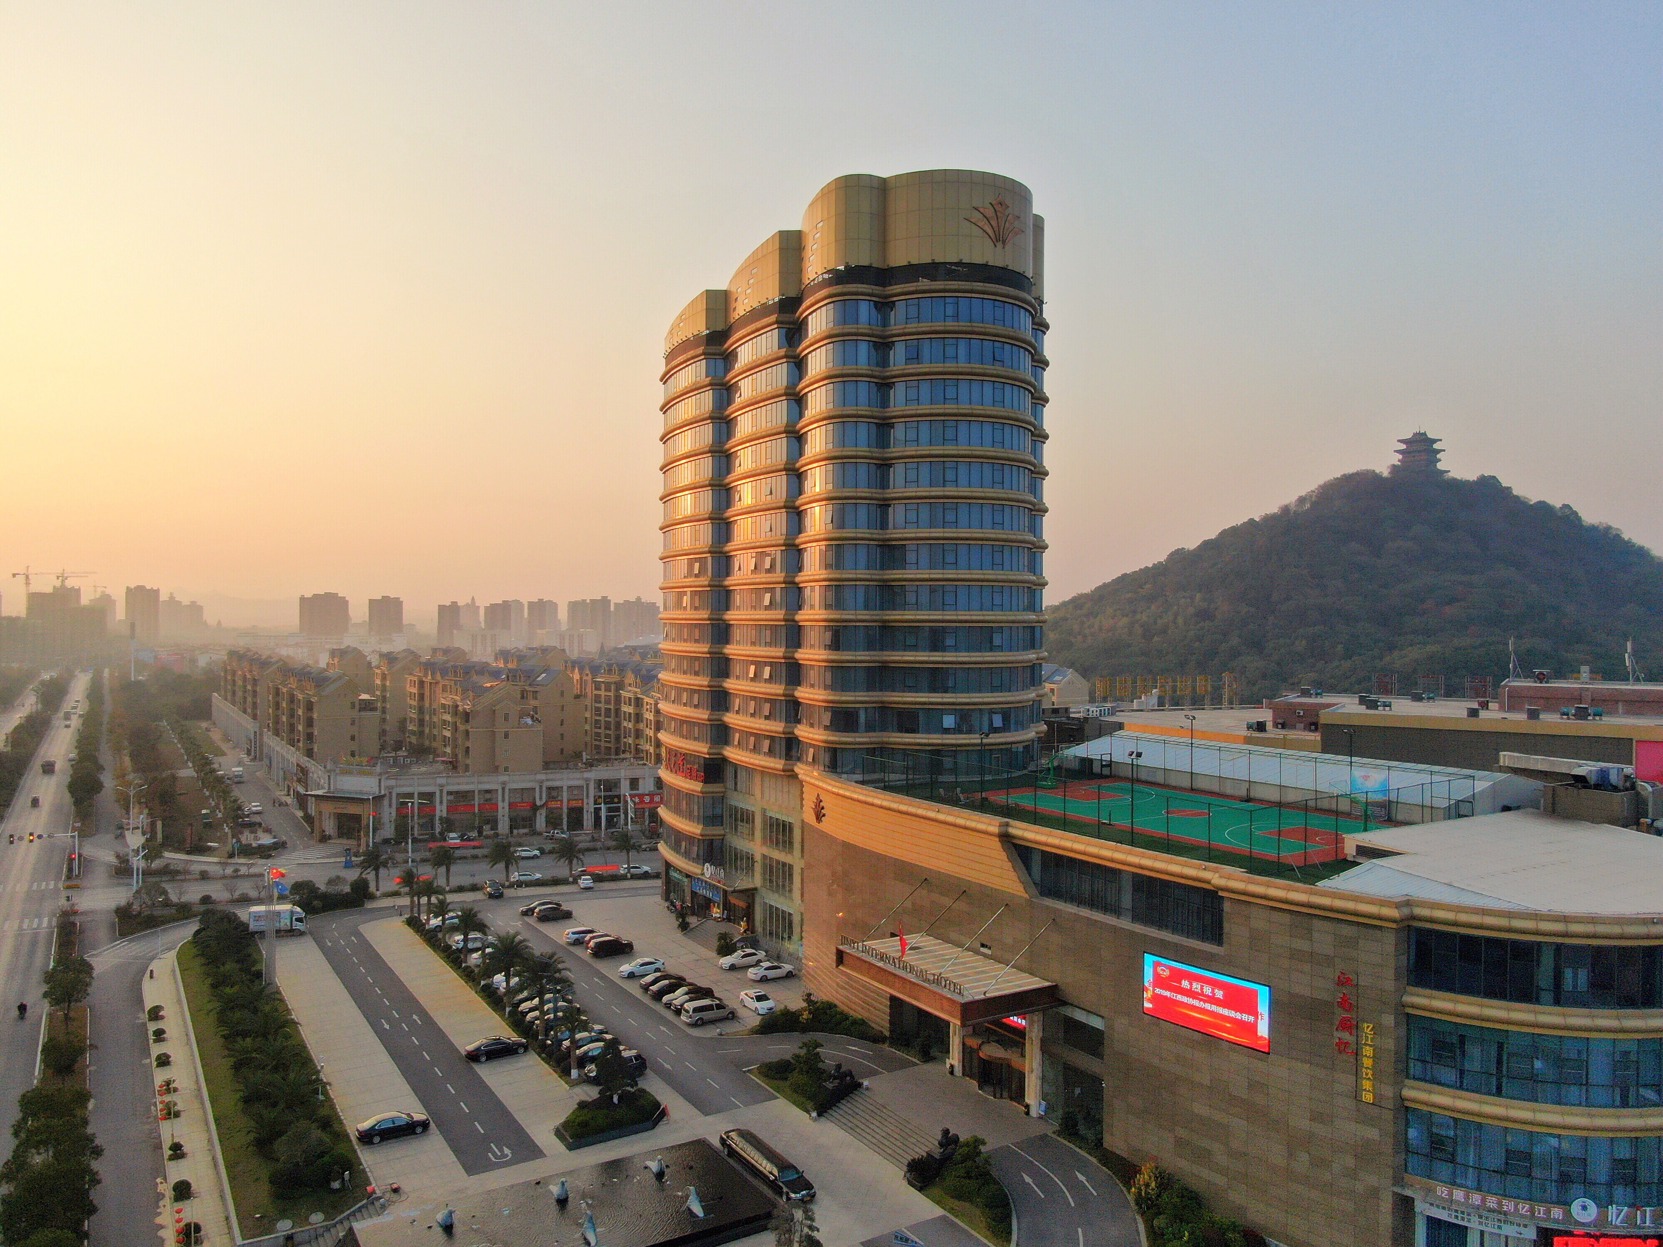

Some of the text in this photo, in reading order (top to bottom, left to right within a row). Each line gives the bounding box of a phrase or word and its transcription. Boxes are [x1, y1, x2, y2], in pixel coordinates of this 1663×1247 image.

[861, 941, 930, 982] INTERNATIONAL
[931, 973, 964, 996] HOTEL
[1181, 979, 1223, 999] 热烈祝贺
[1362, 1022, 1374, 1104] 忆江南餐饮集团
[1436, 1186, 1563, 1220] 吃鹰潭菜到忆江南
